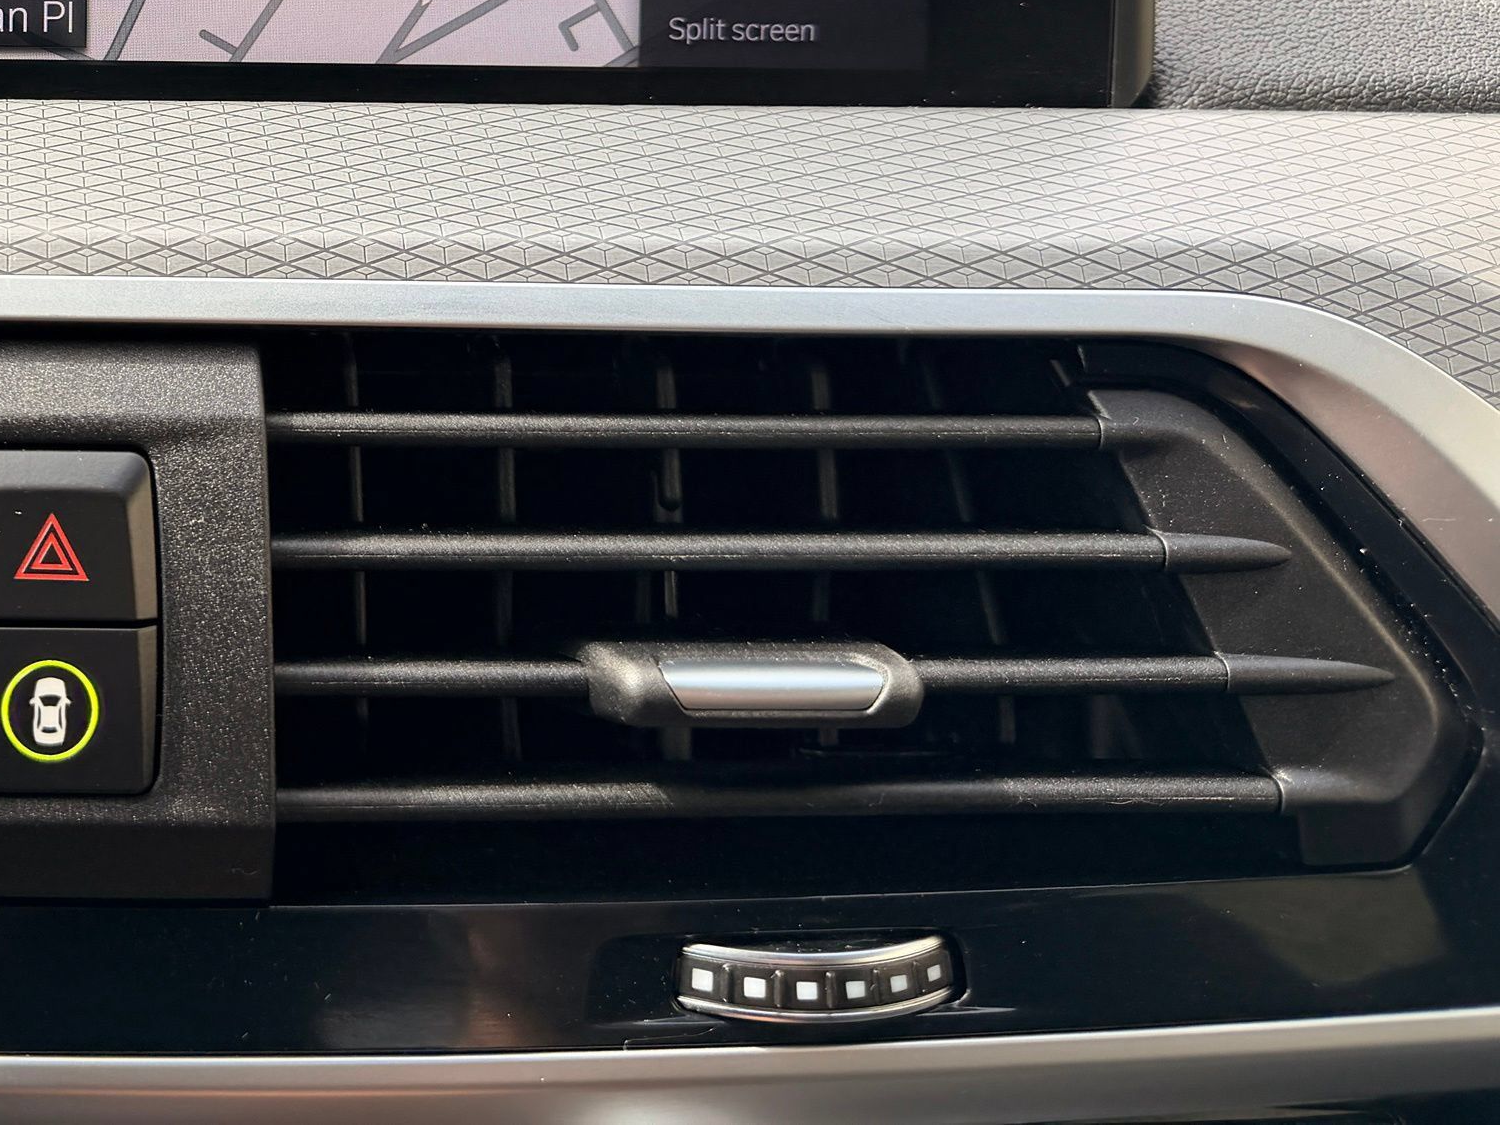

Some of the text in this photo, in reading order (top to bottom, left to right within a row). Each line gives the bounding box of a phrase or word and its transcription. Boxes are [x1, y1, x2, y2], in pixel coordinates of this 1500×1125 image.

[43, 0, 74, 33] Pl
[668, 17, 817, 45] Split screen
